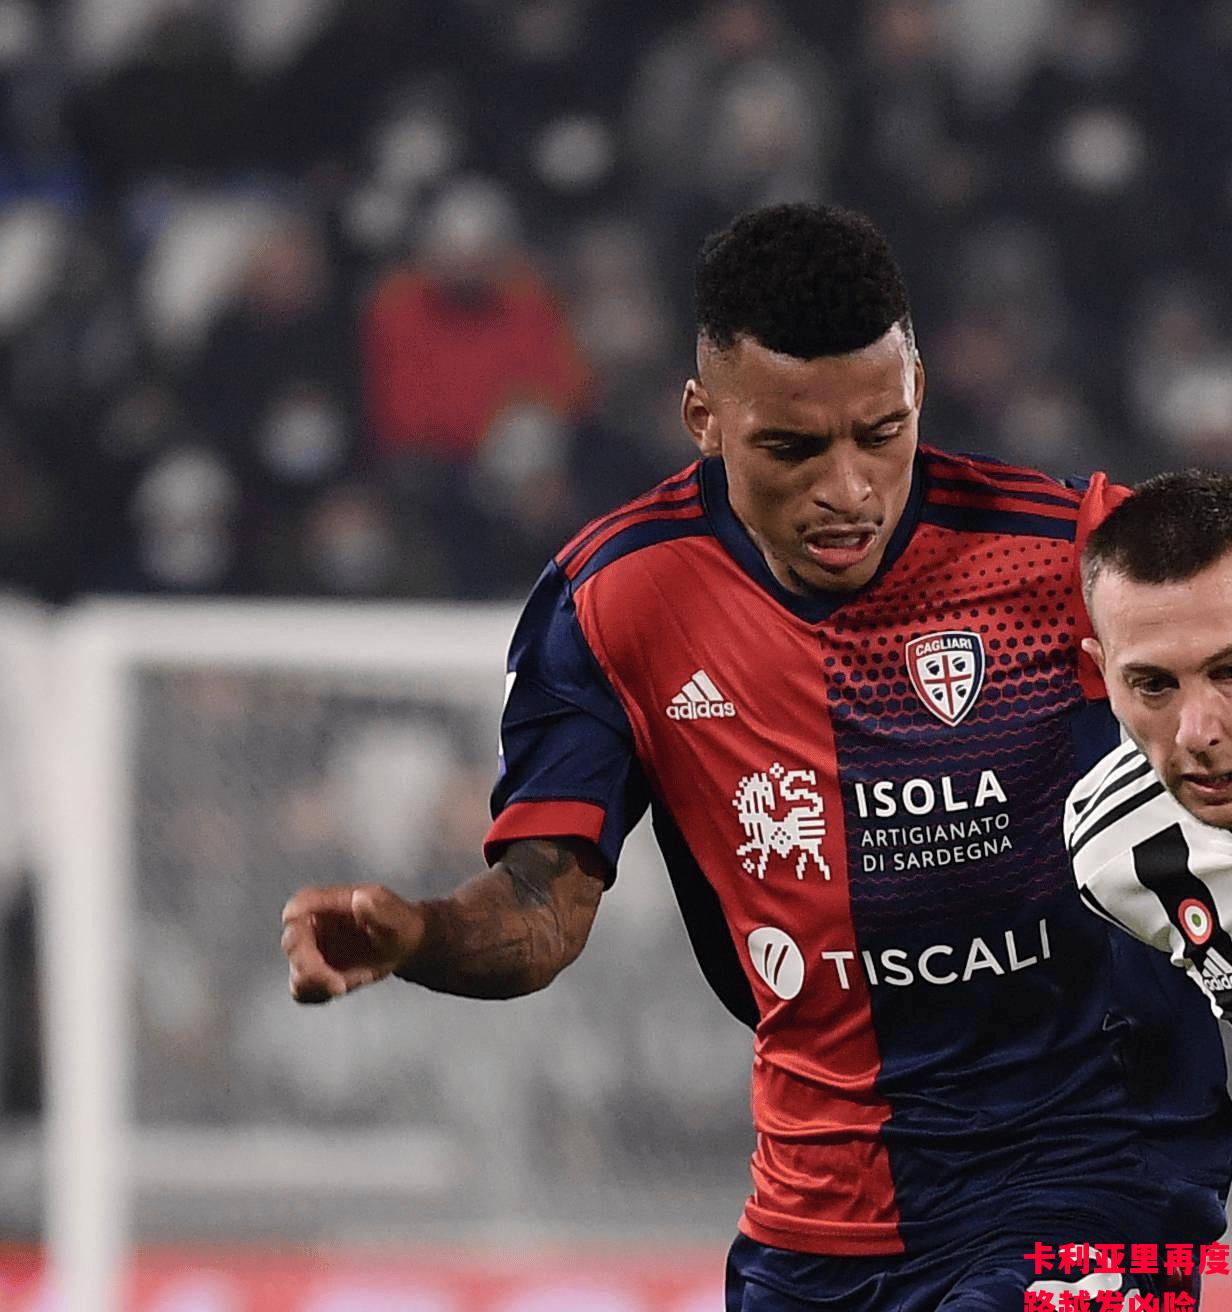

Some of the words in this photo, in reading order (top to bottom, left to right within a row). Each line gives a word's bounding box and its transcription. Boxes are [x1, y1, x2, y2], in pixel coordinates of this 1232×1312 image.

[915, 637, 973, 657] CAGLIARI
[666, 699, 736, 721] adidas
[855, 770, 1007, 818] ISOLA
[861, 813, 1010, 848] ARTIGIANATO
[863, 853, 885, 873] DI
[893, 835, 1013, 872] SARDEGNA
[822, 919, 1052, 990] TISCALI
